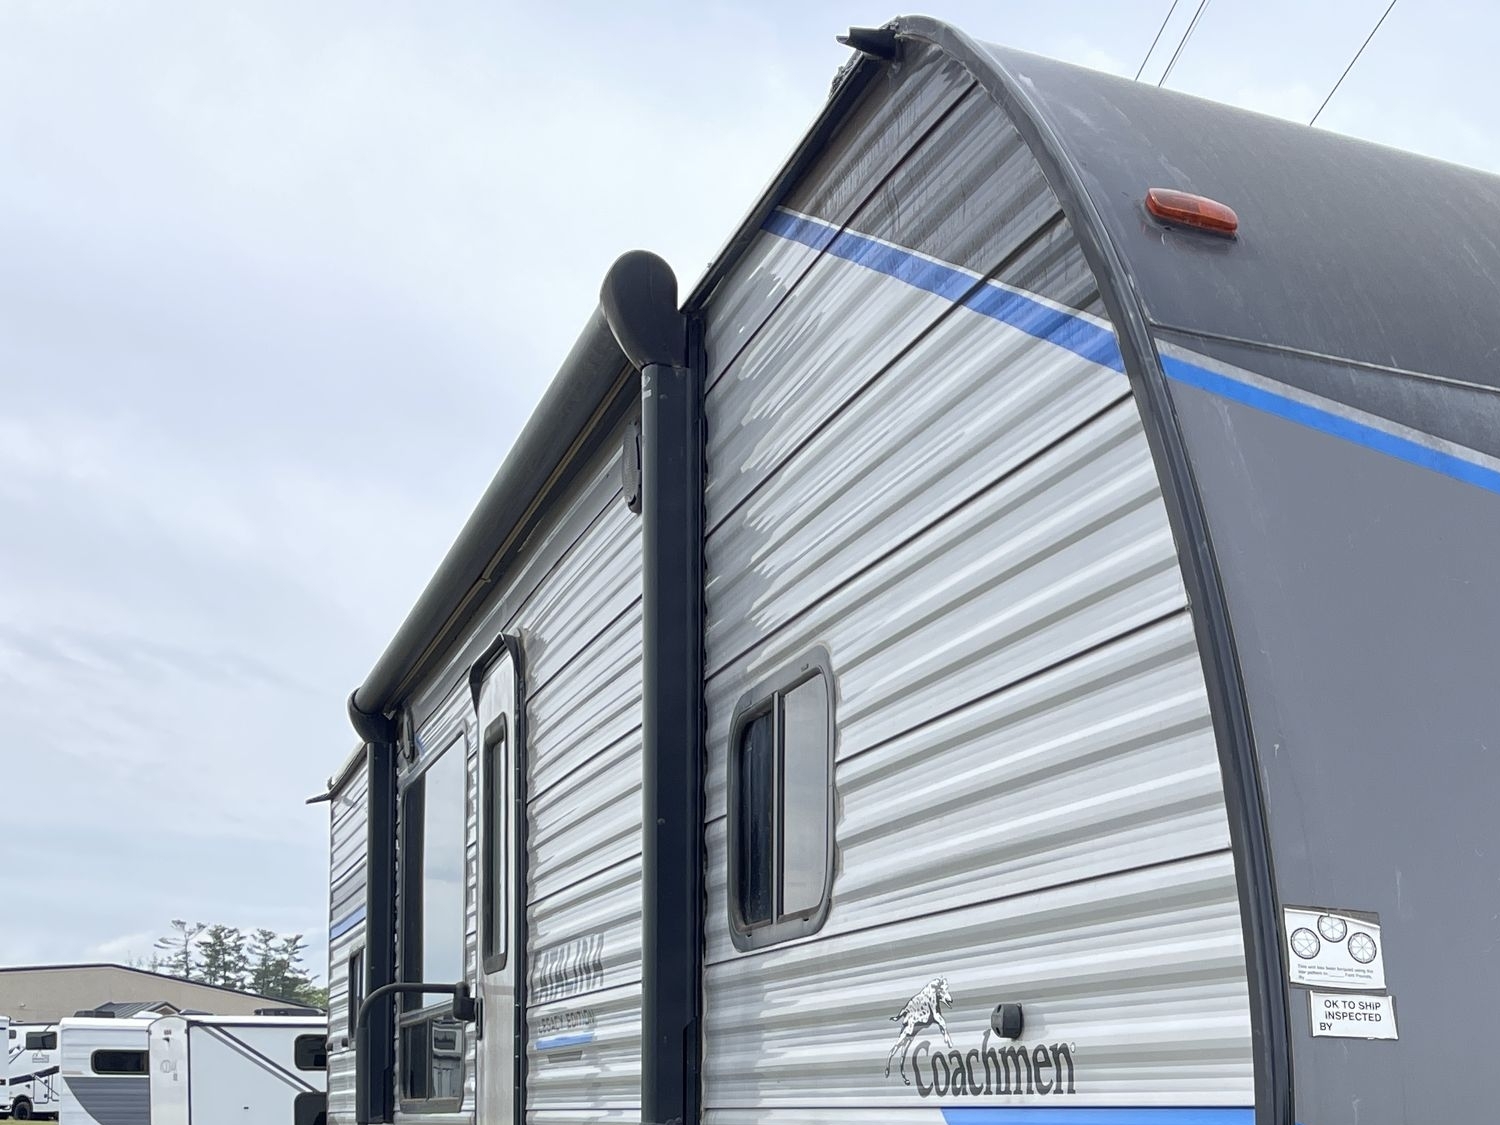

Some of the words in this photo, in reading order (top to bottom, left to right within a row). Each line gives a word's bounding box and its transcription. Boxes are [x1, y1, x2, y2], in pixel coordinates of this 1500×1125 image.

[1324, 1000, 1339, 1009] OK
[1342, 1000, 1355, 1010] TO
[1358, 1001, 1381, 1011] SHIP
[1325, 1011, 1382, 1022] INSPECTED
[1320, 1022, 1333, 1031] BY
[912, 1029, 1076, 1098] Coachmen
